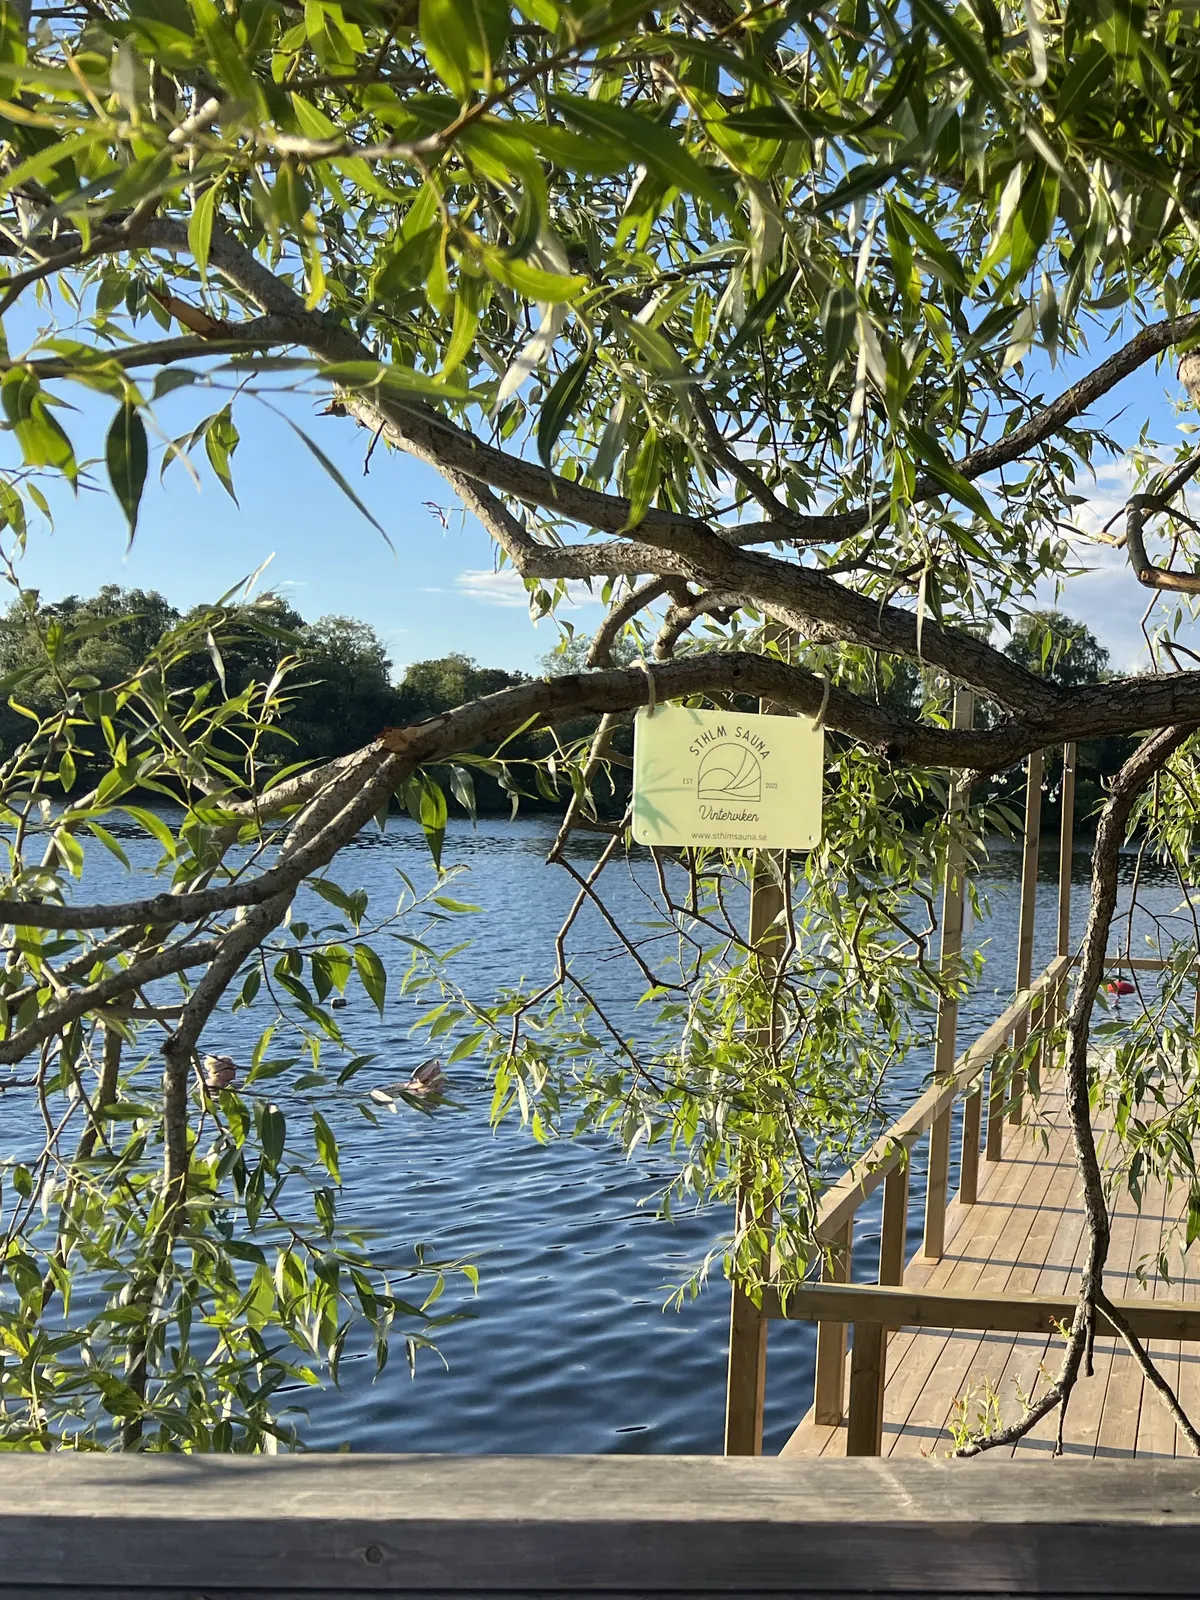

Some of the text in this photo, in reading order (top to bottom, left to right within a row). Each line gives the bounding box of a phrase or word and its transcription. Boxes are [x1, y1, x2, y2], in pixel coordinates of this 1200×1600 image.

[689, 725, 771, 760] STHLM SAUNA
[698, 804, 760, 823] Vinterviken
[691, 832, 768, 841] www.sthlmsauna.se
